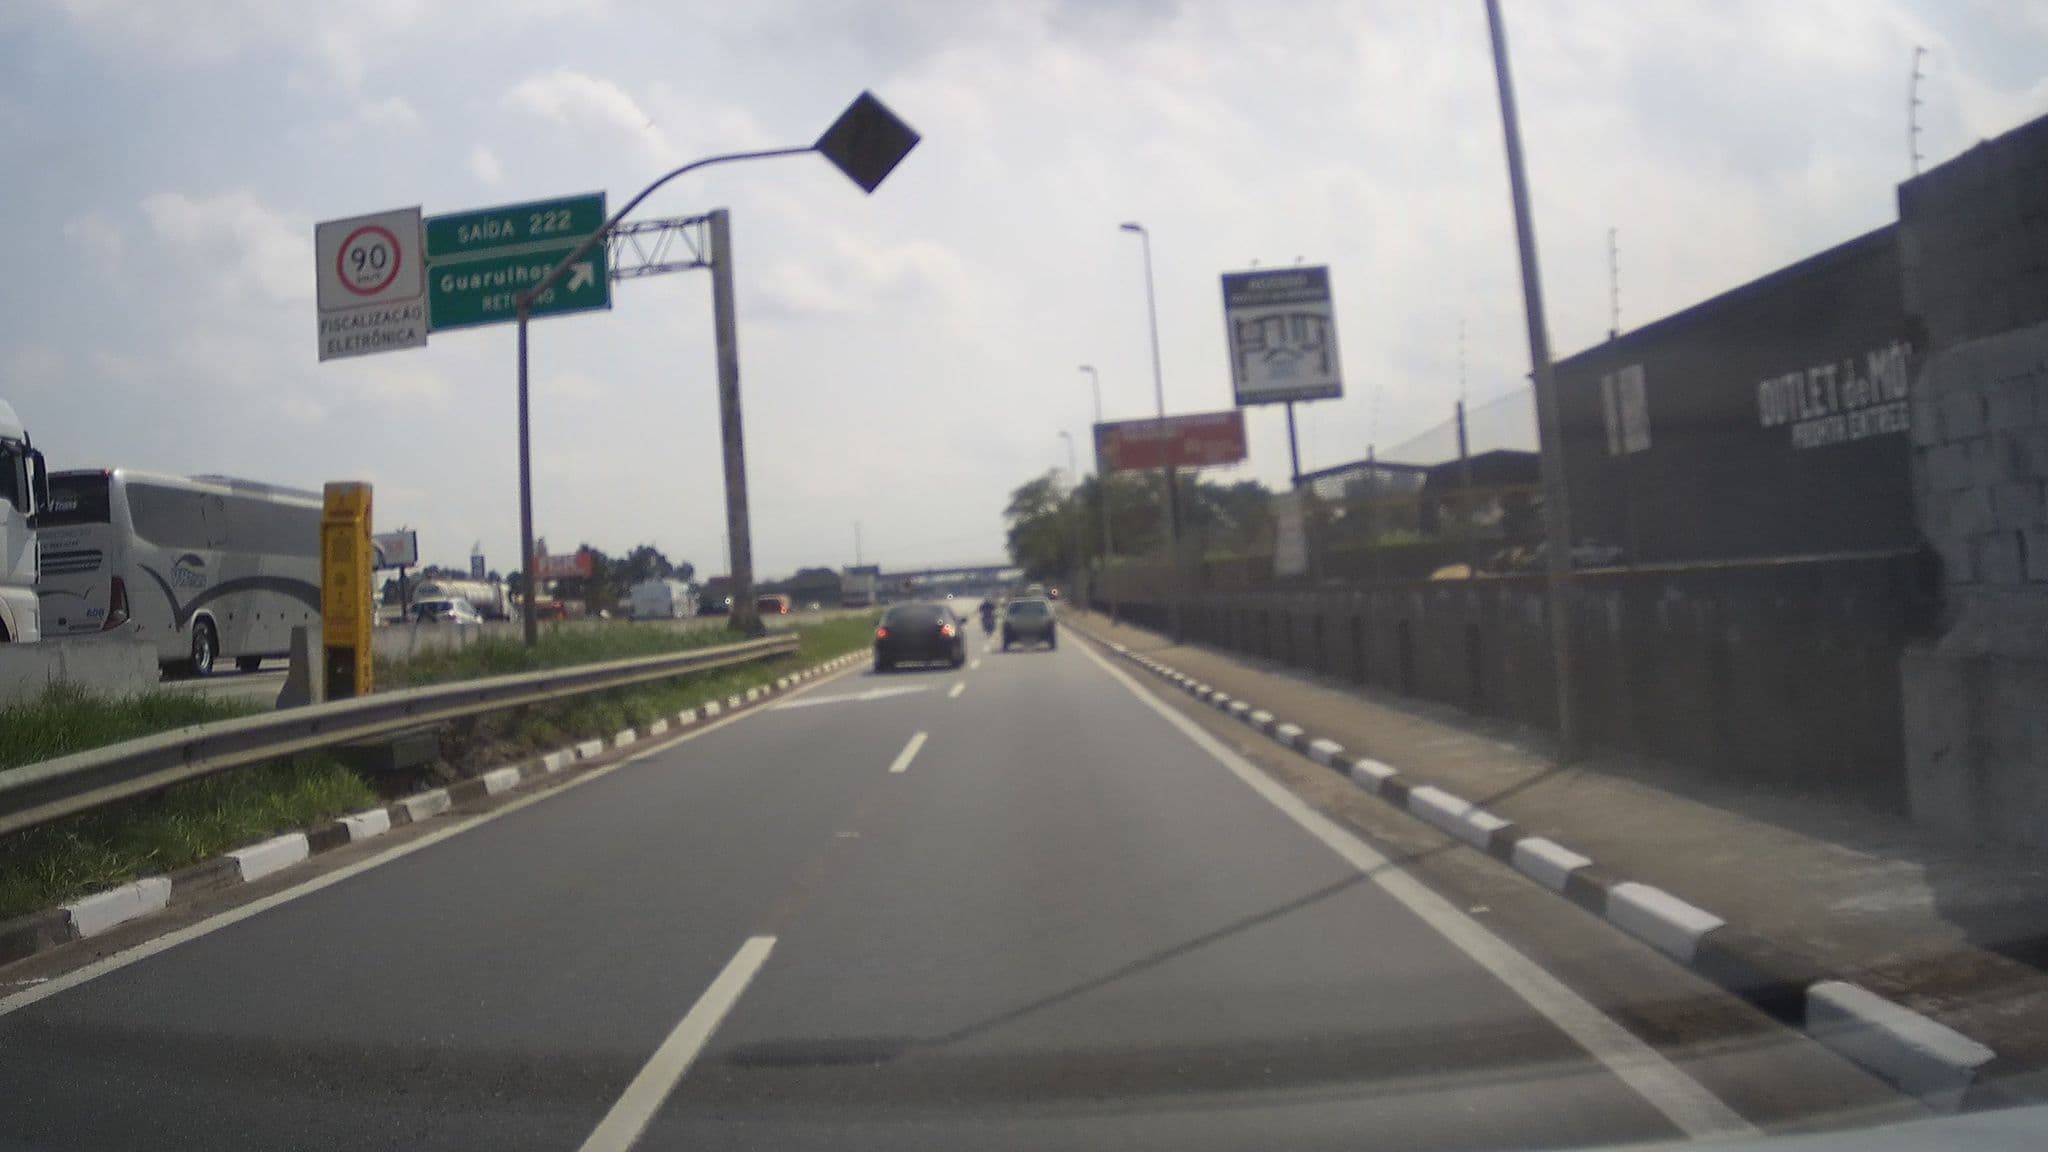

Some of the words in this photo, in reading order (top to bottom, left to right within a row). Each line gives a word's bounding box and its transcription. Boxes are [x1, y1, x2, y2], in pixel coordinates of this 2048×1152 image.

[529, 209, 573, 235] 222
[351, 243, 388, 272] 90
[440, 263, 555, 293] Guarulhos
[1759, 364, 1839, 428] OUTLET
